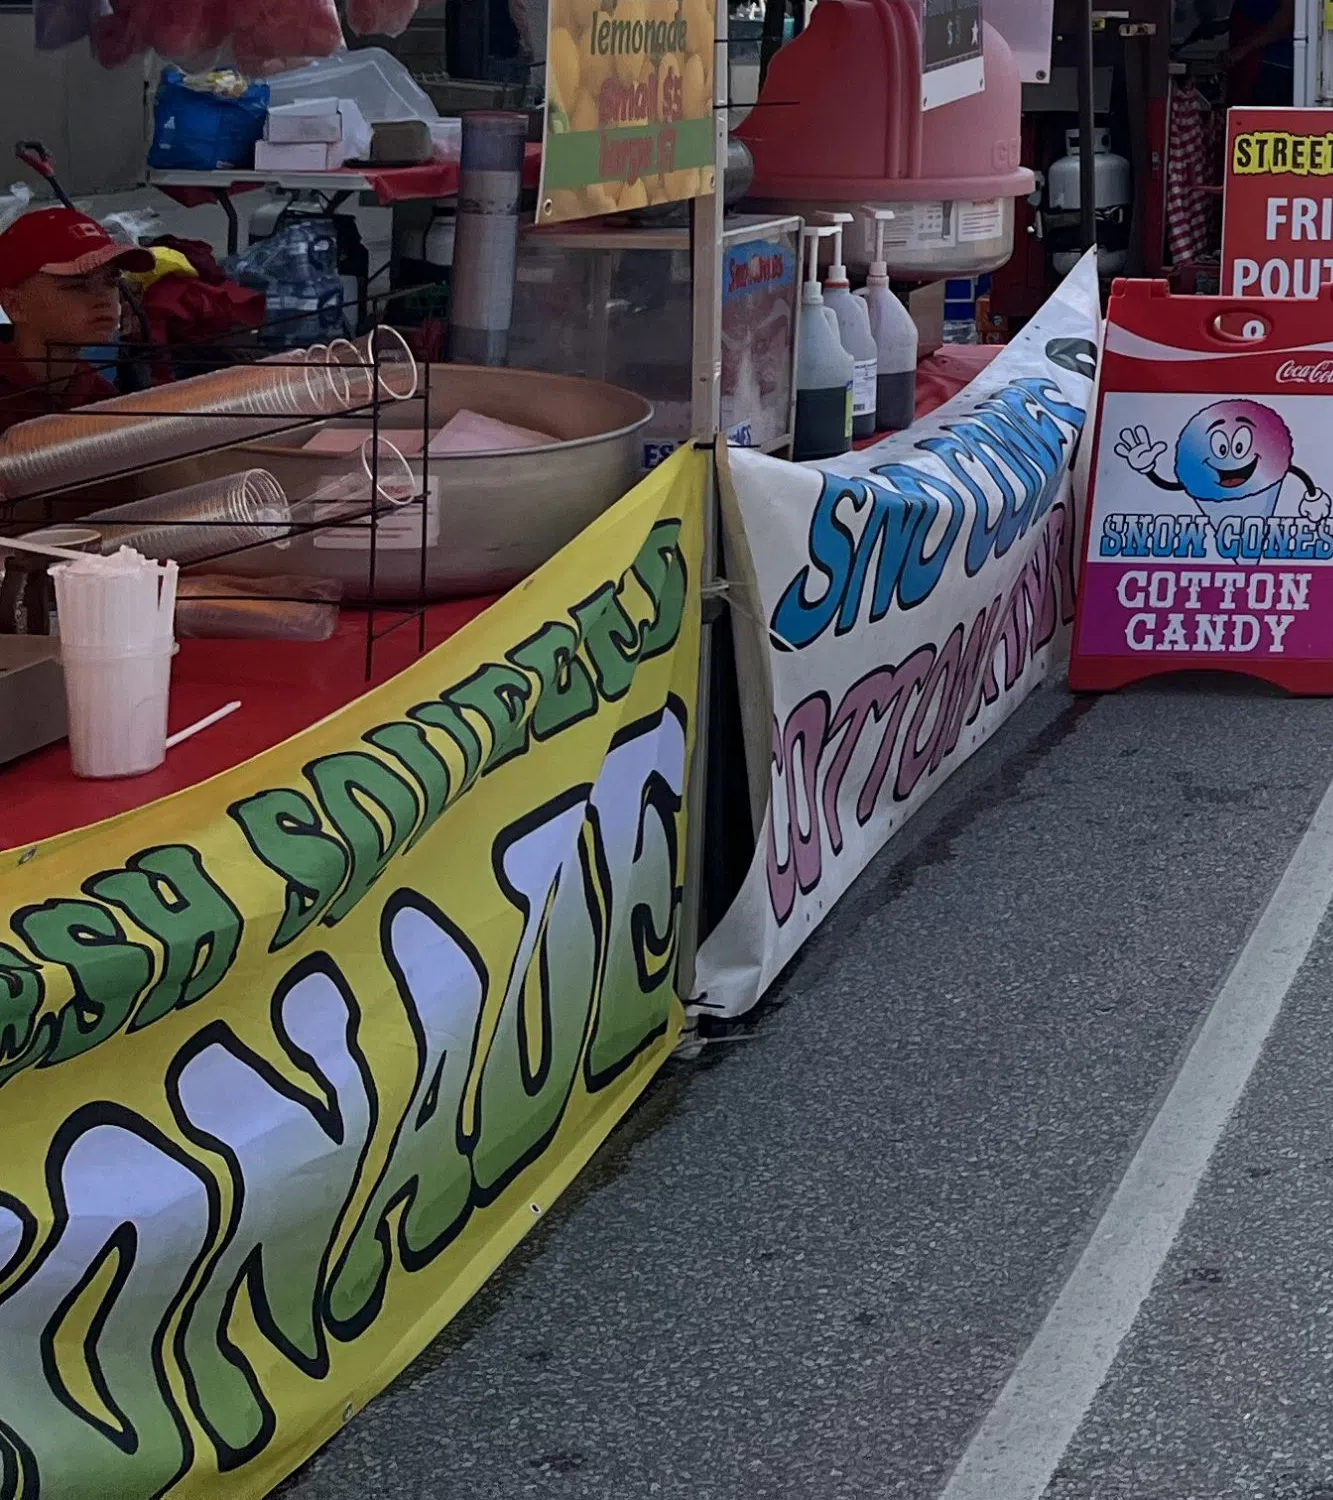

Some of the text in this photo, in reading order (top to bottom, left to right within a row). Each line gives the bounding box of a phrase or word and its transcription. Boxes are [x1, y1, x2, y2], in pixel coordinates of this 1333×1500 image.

[590, 10, 687, 56] lemonade
[1100, 513, 1209, 558] SNOW
[1116, 569, 1313, 611] COTTON
[1124, 612, 1296, 653] CANDY
[0, 691, 687, 1500] ONADE
